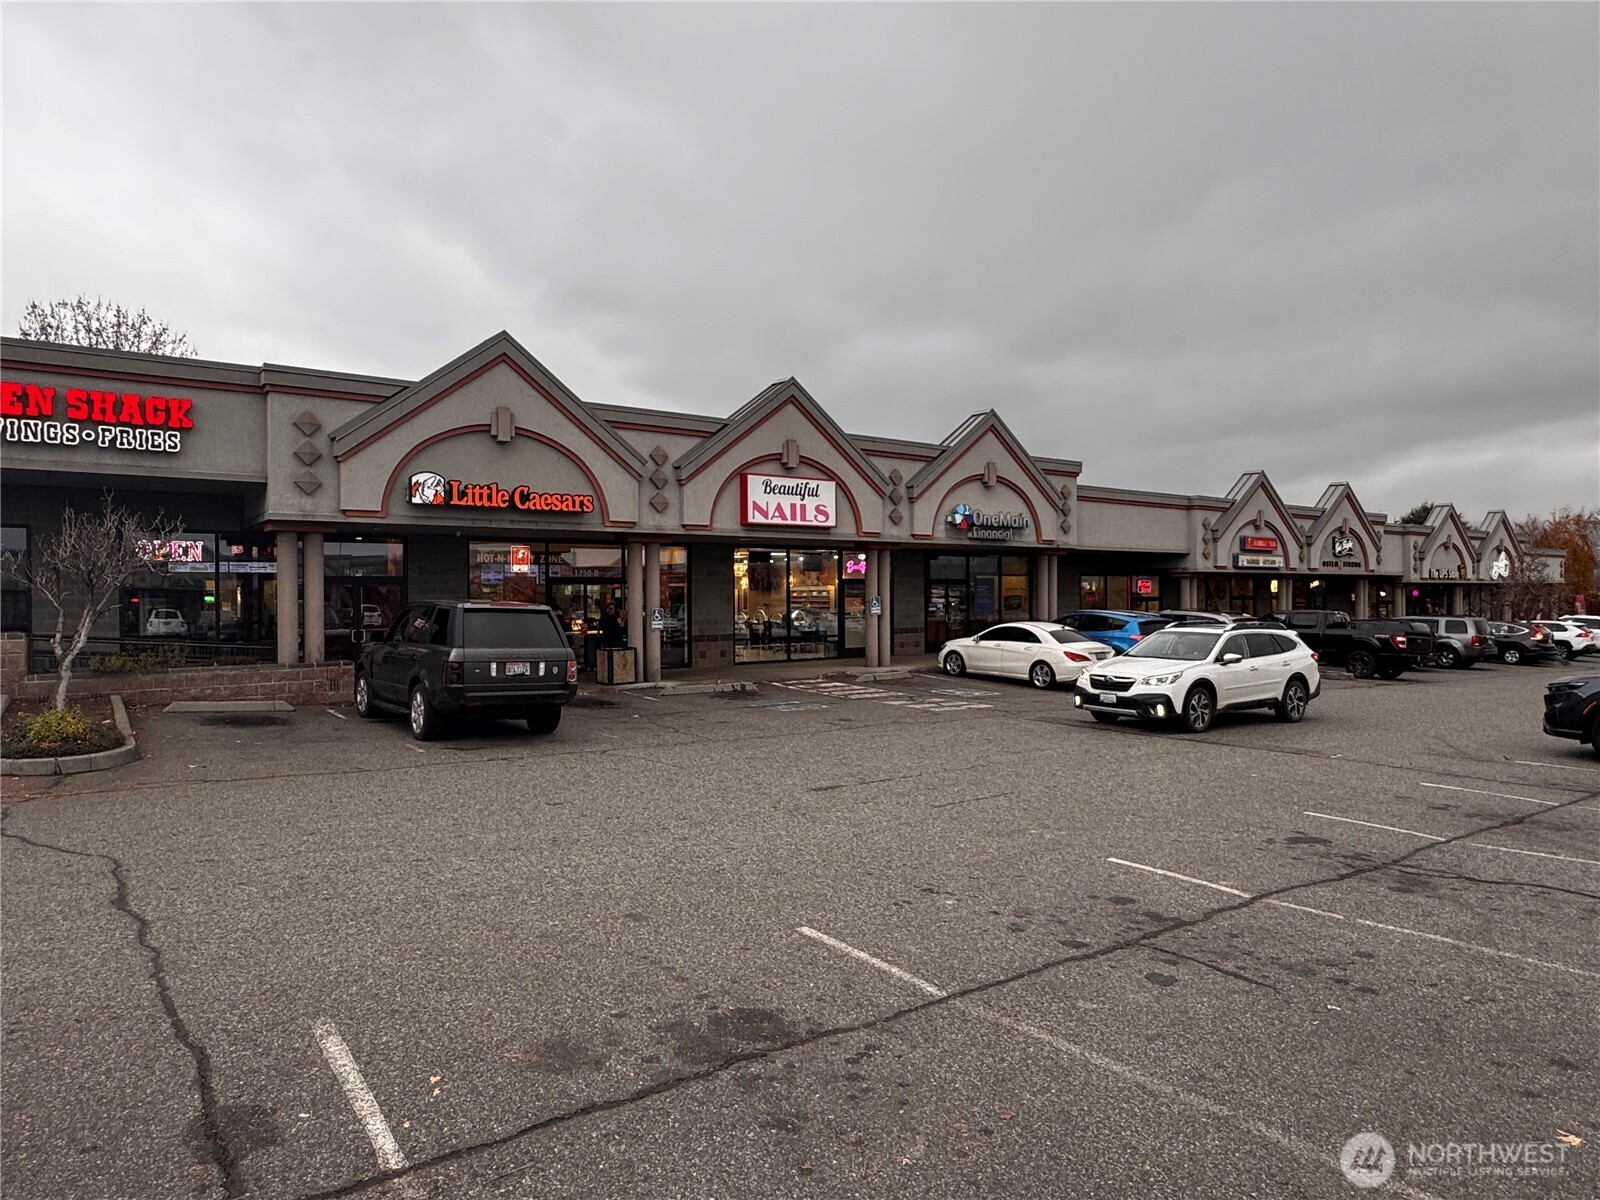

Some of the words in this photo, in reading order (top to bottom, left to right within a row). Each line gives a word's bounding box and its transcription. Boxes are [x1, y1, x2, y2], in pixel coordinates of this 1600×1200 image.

[65, 389, 193, 428] SHACK
[0, 418, 79, 445] INGS
[98, 425, 181, 452] FRIES
[450, 481, 509, 507] Little
[514, 486, 594, 512] Caesars
[762, 478, 820, 501] Beautiful
[752, 501, 830, 523] NAILS
[973, 510, 1030, 528] OneMain
[973, 526, 1013, 540] Financial
[135, 540, 204, 562] OPEN
